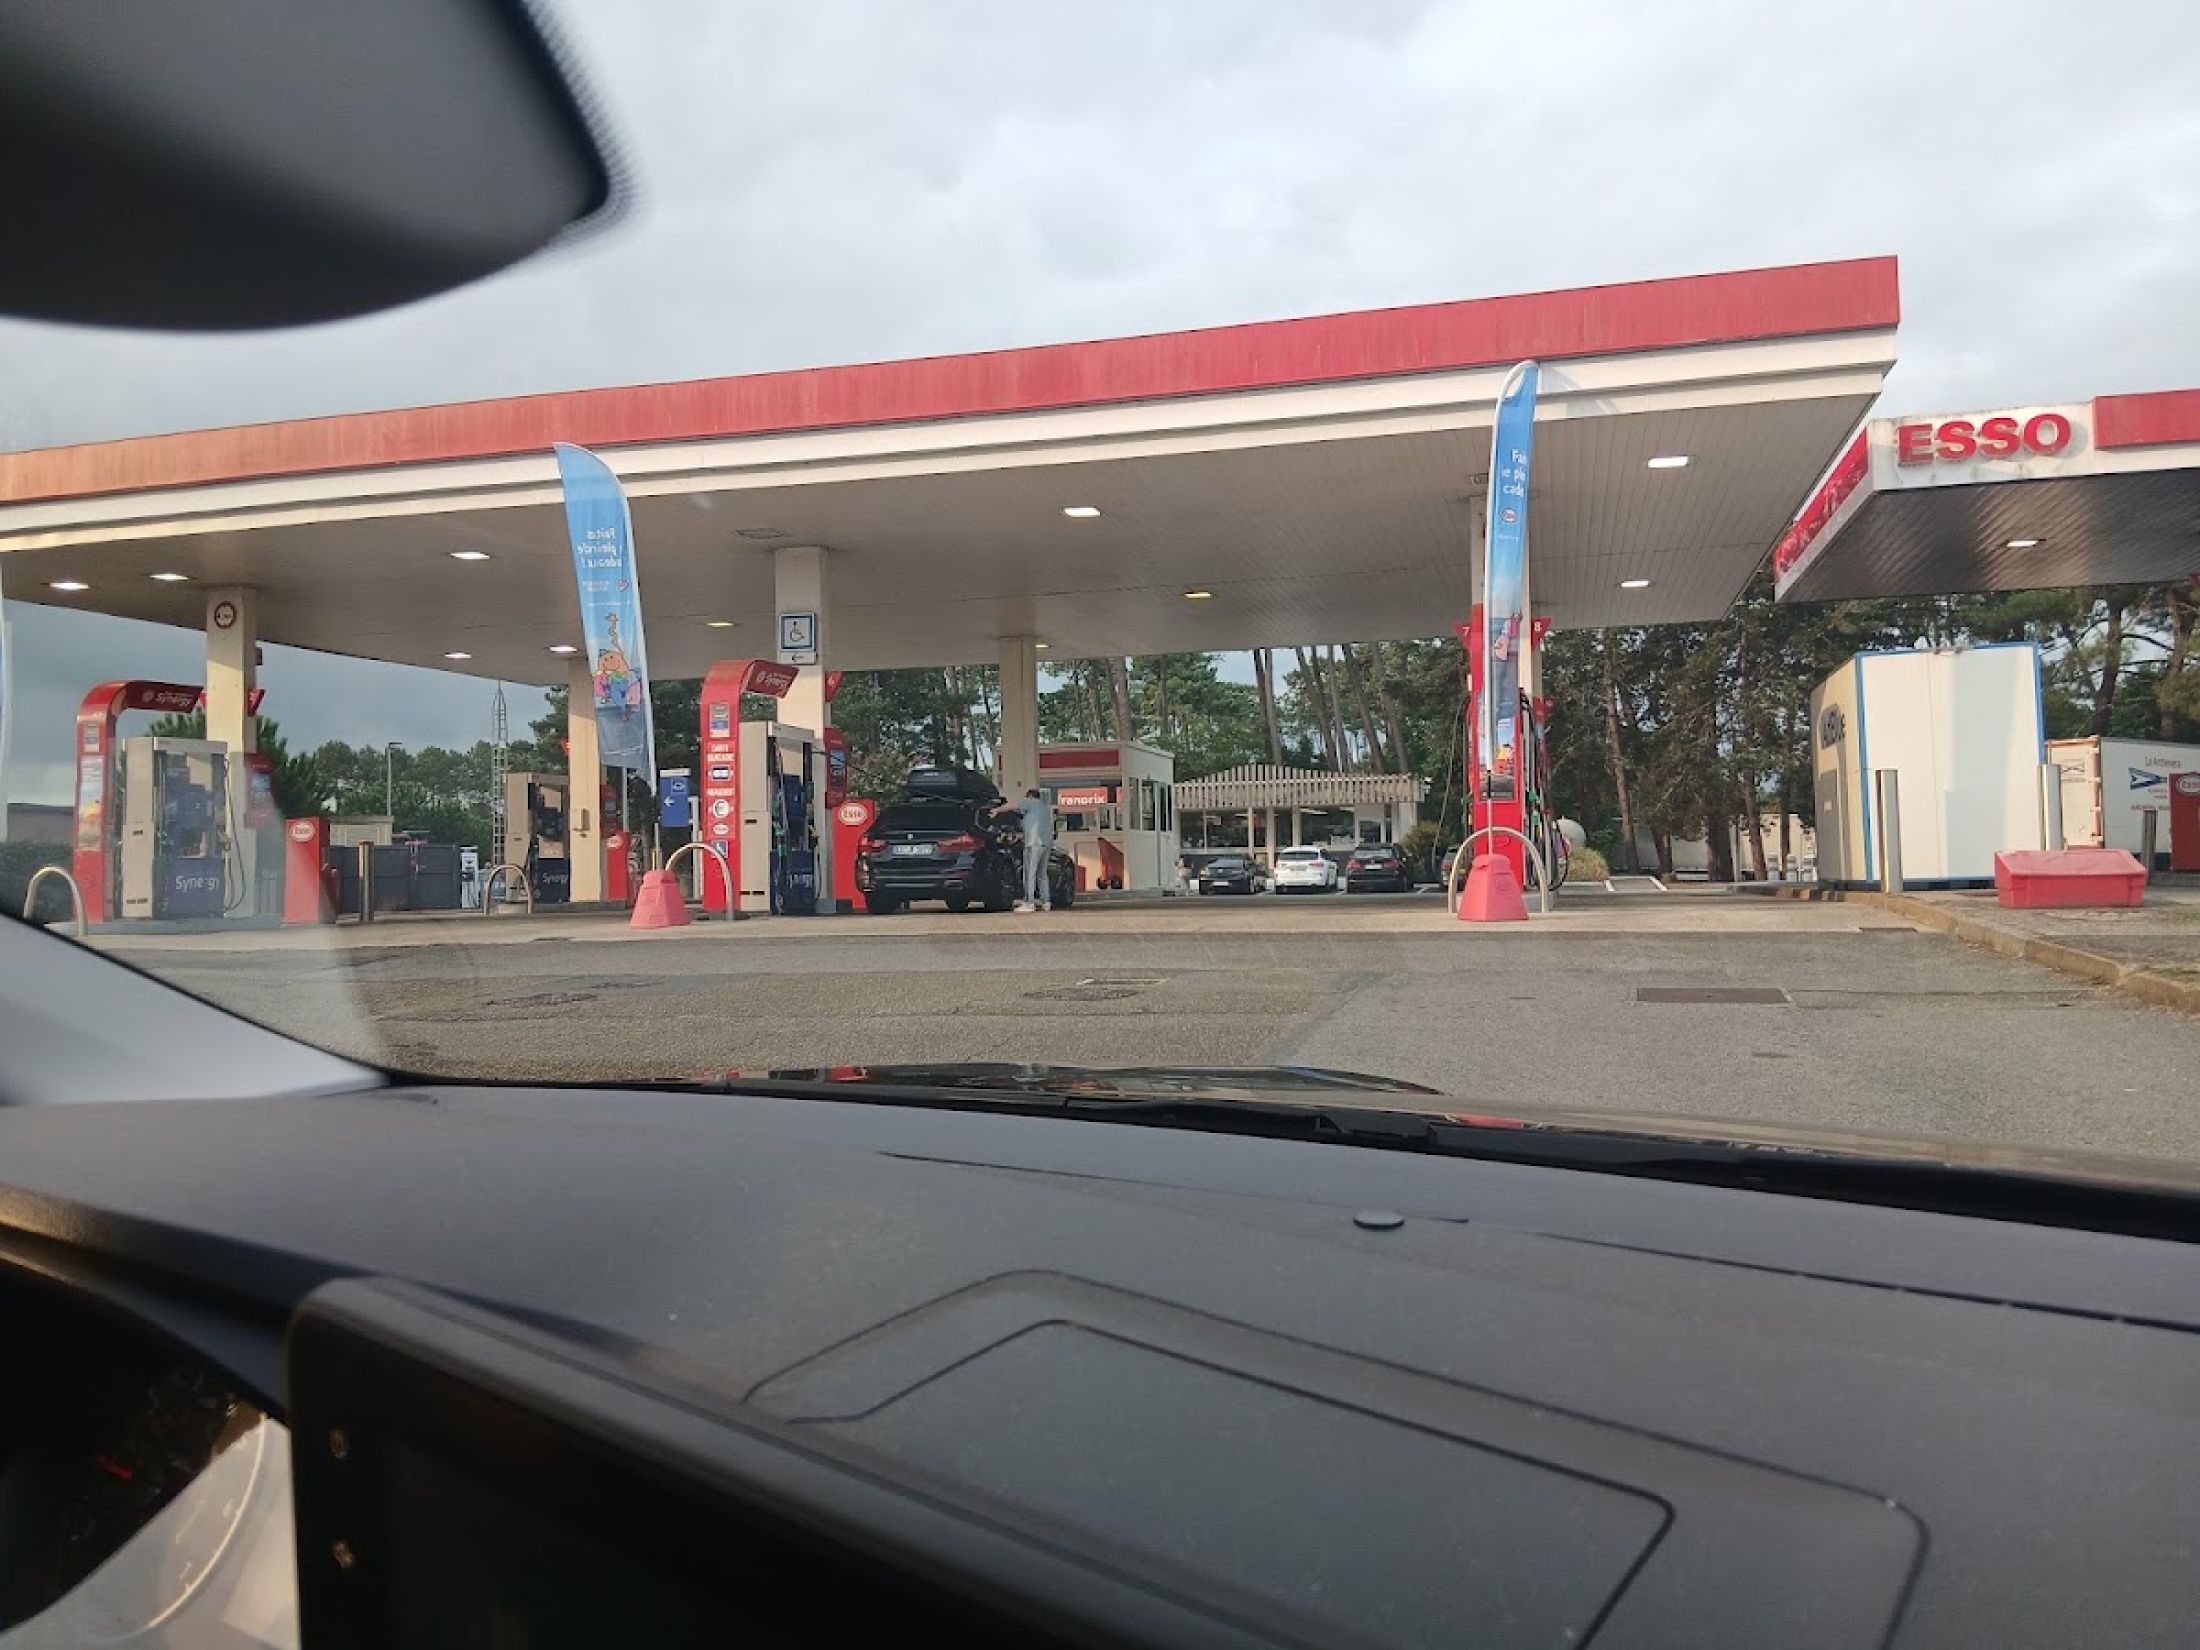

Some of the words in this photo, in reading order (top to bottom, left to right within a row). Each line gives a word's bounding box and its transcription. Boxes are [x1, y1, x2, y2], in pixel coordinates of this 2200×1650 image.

[1897, 413, 2071, 467] ESSO
[1462, 626, 1471, 637] 7
[1534, 621, 1542, 632] 8
